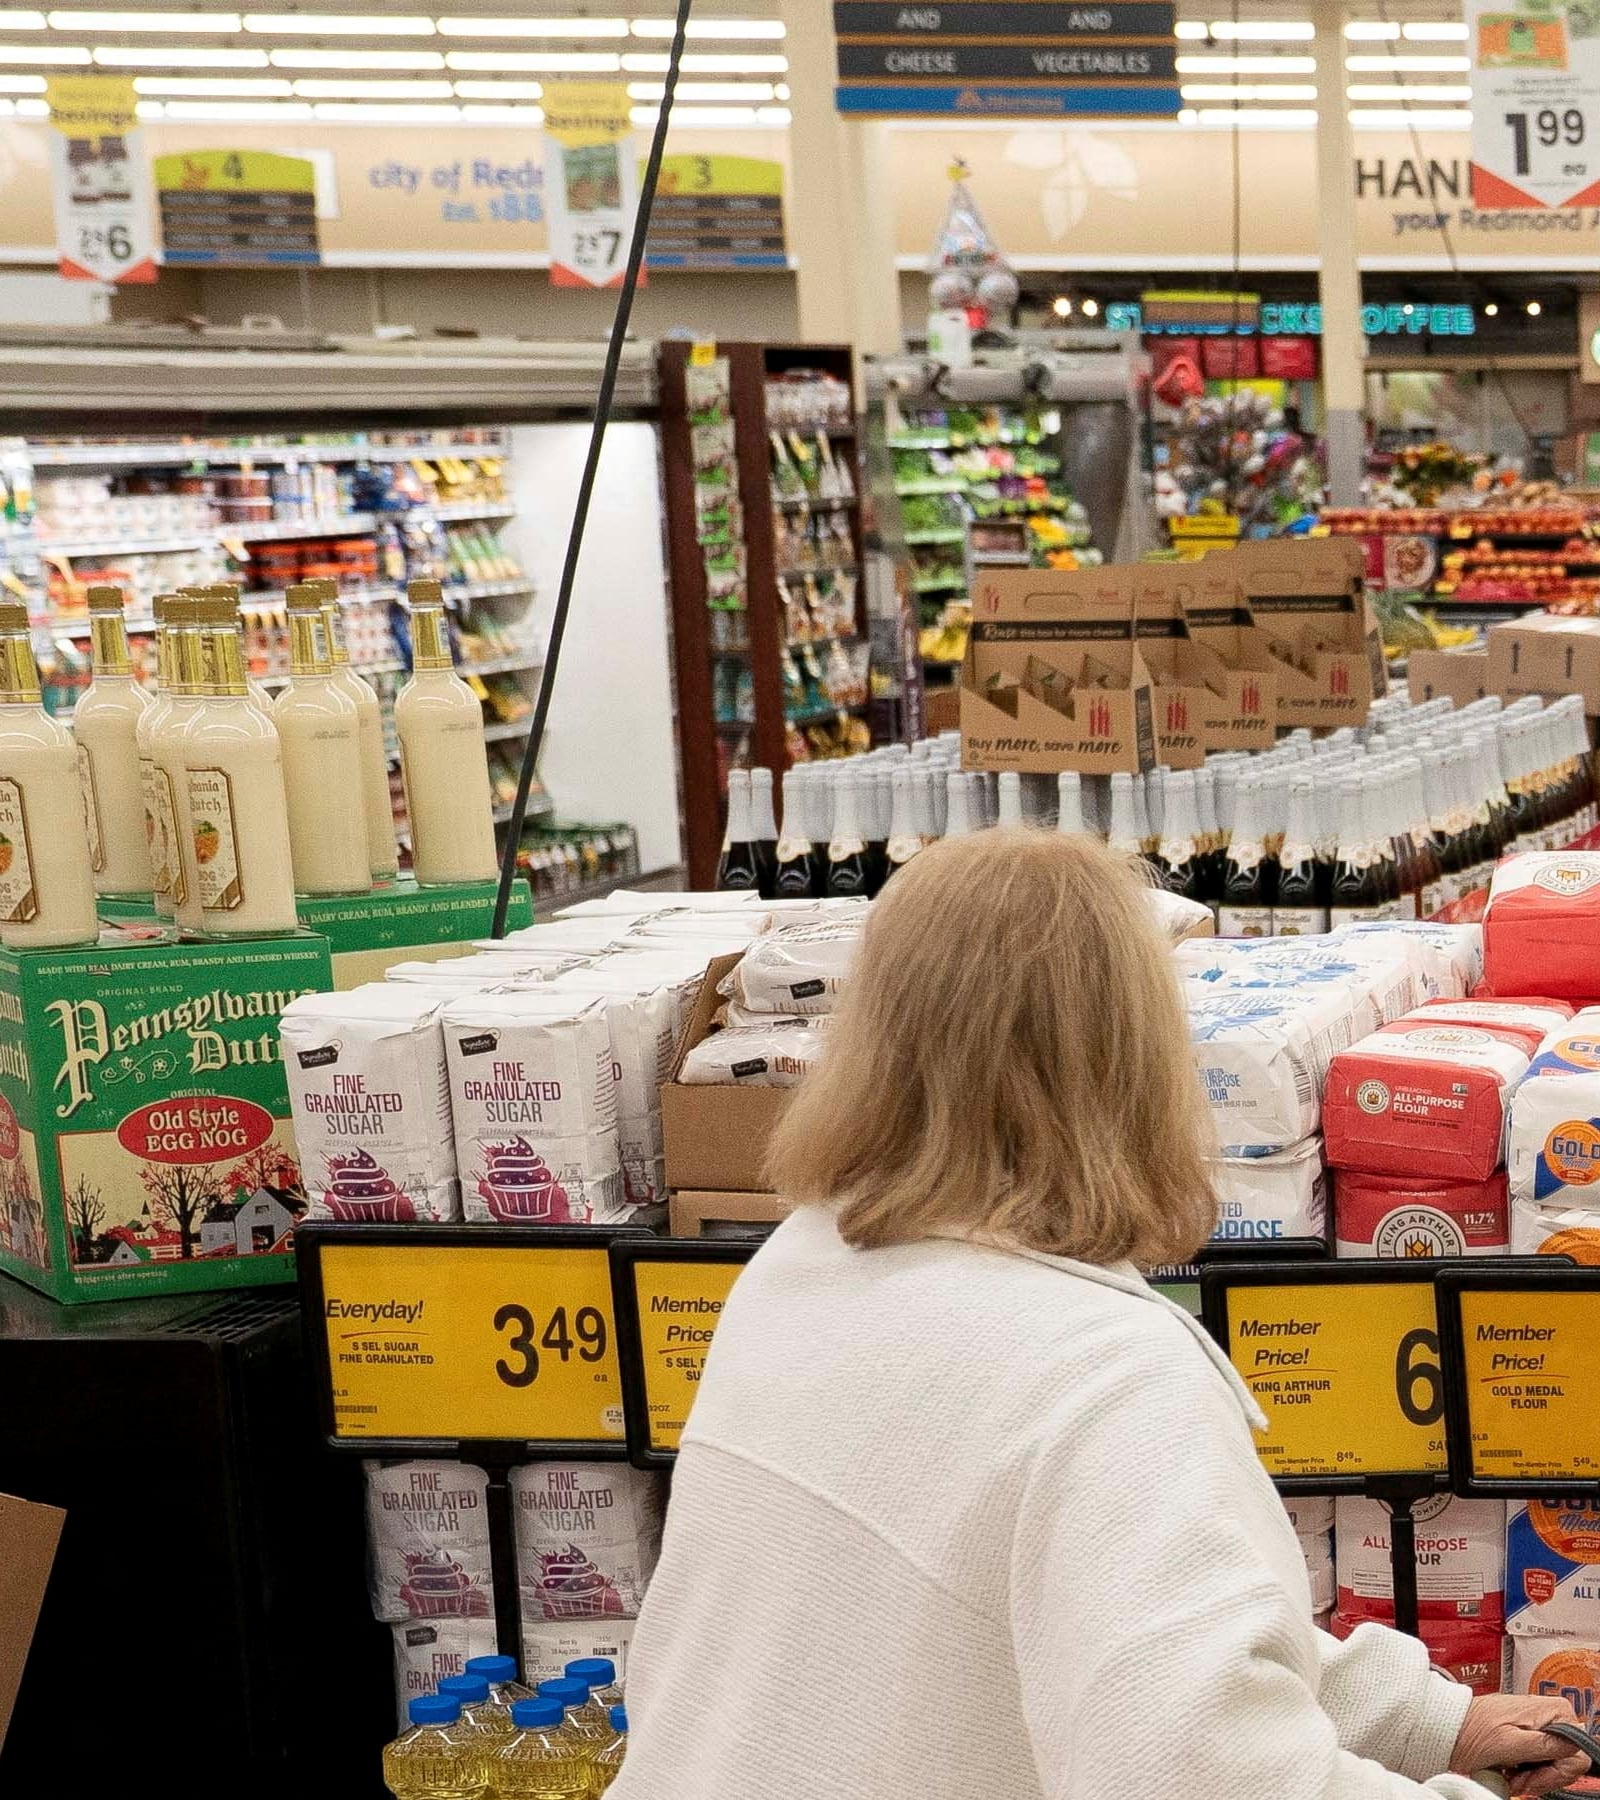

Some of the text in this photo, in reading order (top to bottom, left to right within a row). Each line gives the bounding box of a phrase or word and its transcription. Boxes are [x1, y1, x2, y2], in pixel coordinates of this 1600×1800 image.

[885, 53, 957, 73] CHEESE
[221, 153, 244, 181] 4
[368, 160, 463, 191] city of
[1392, 208, 1582, 235] your Redmond
[333, 1074, 365, 1094] FINE
[304, 1093, 403, 1113] GRANULATED
[1393, 1093, 1465, 1109] ALL-PURPOSE
[149, 1106, 240, 1132] Old Style
[326, 1114, 385, 1135] SUGAR
[147, 1128, 248, 1153] EGG NOG
[1463, 1213, 1495, 1225] 11.7%
[325, 1298, 425, 1323] Everyday!
[1239, 1319, 1321, 1337] Member
[352, 1341, 420, 1352] S SEL SUGAR
[1254, 1348, 1310, 1366] Price!
[1253, 1380, 1331, 1393] KING ARTHUR
[1492, 1386, 1565, 1397] GOLD MEDAL
[1273, 1394, 1312, 1405] FLOUR
